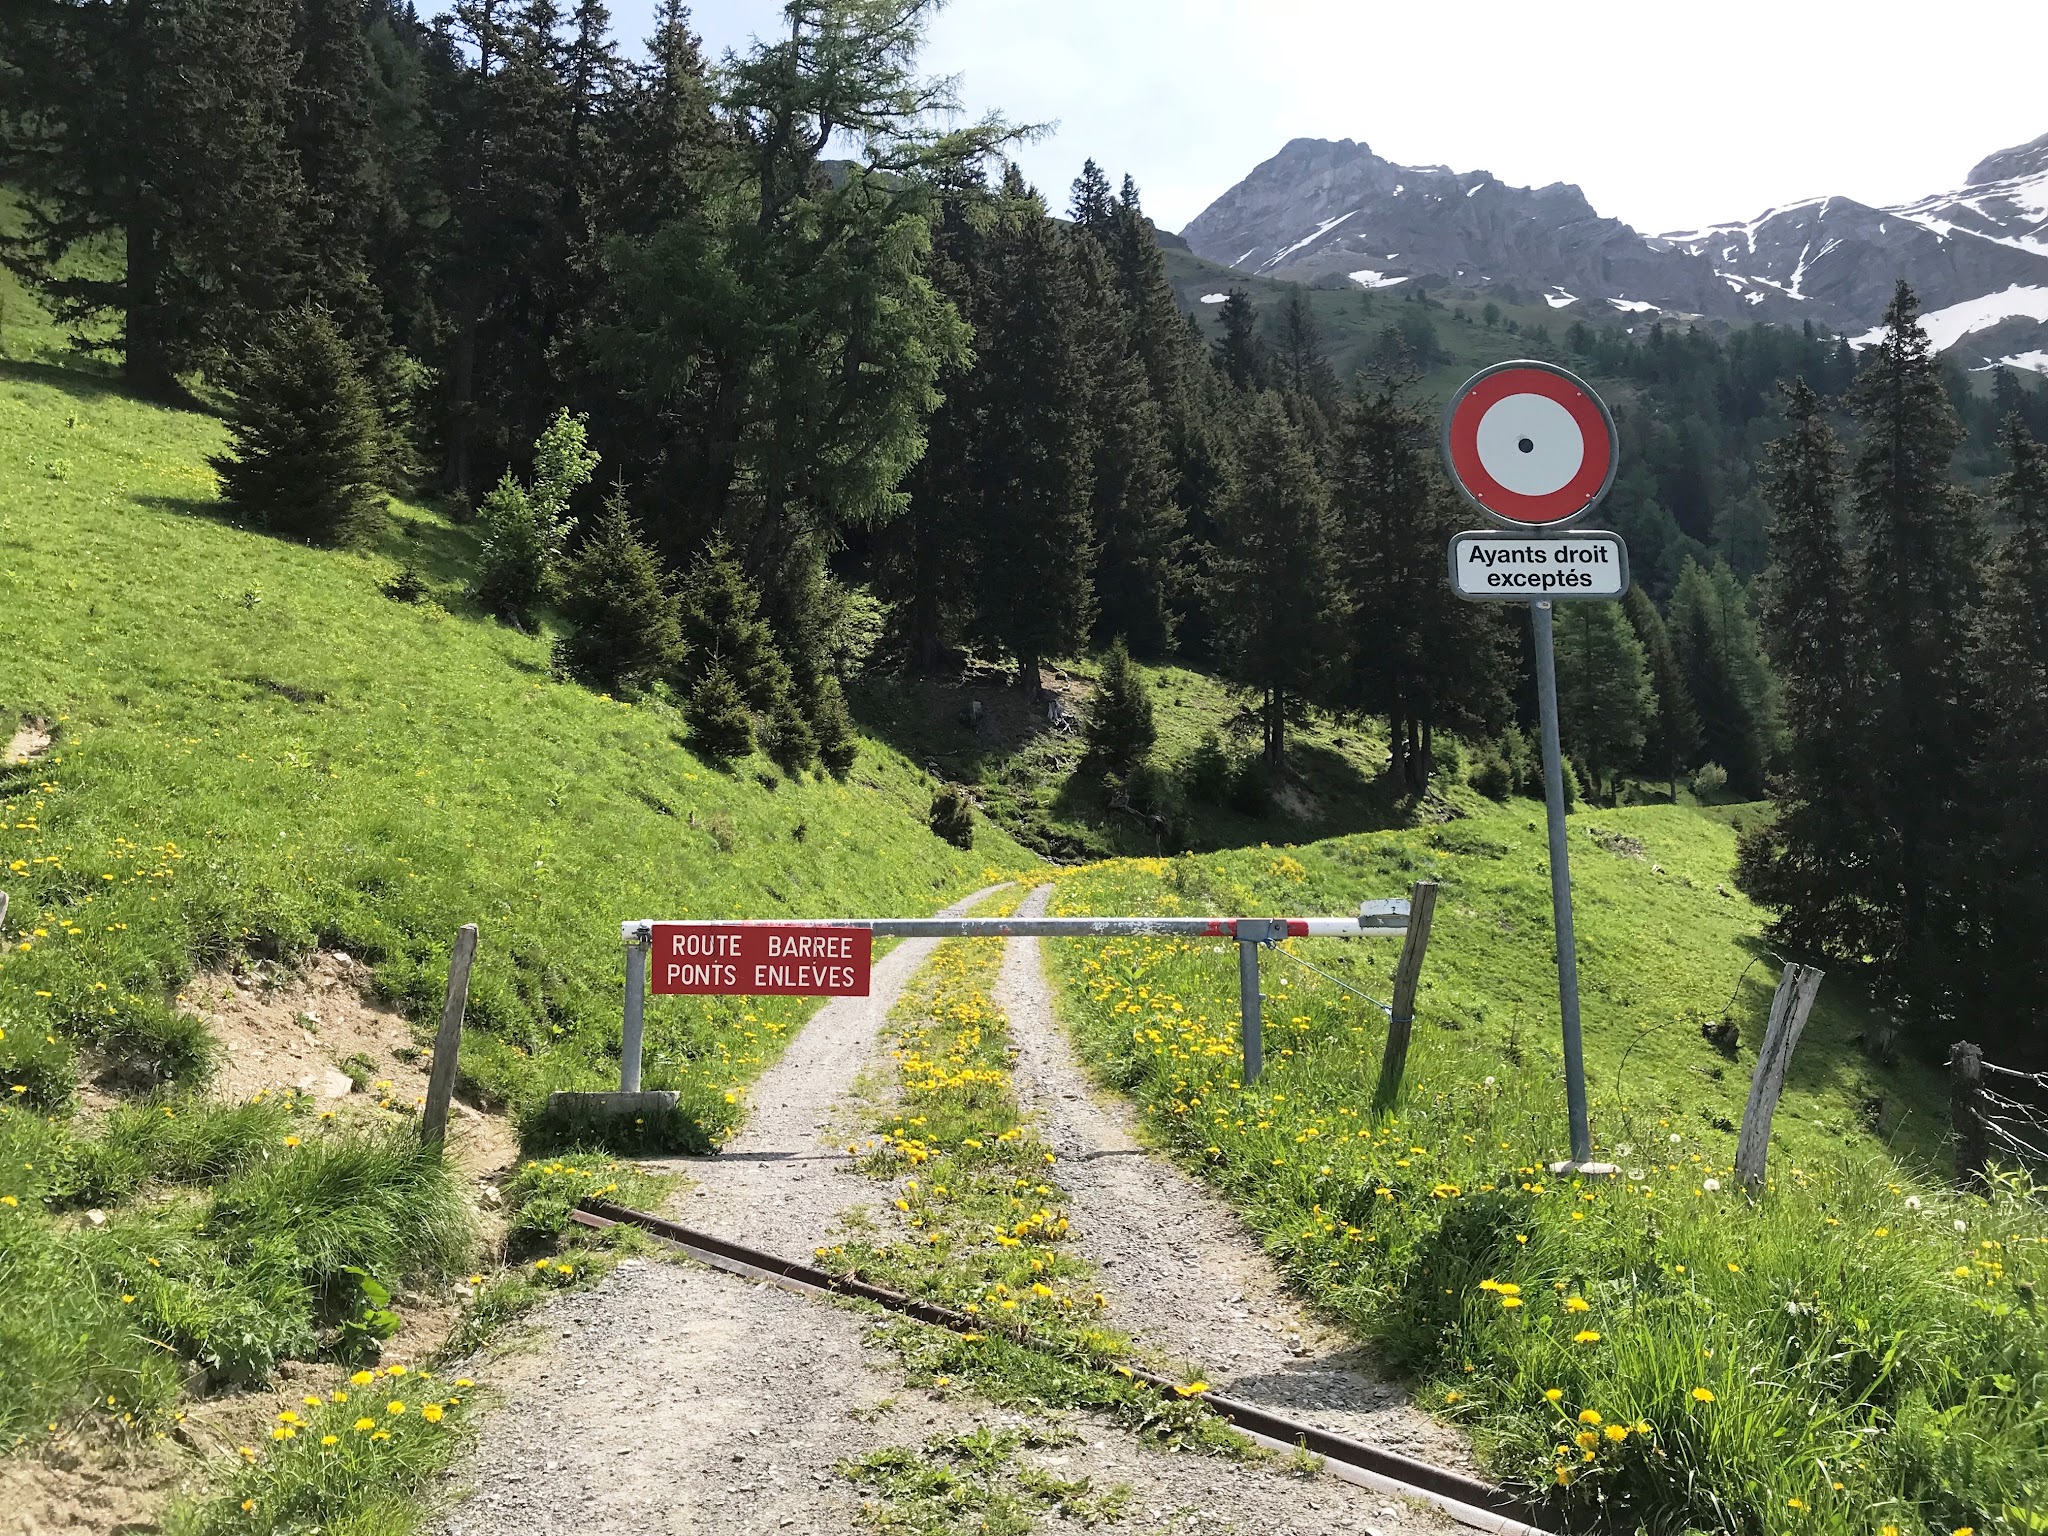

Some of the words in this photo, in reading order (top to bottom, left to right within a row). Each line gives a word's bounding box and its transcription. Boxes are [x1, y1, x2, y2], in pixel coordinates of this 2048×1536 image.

[1469, 545, 1547, 567] Ayants
[1554, 545, 1608, 563] droit
[1487, 568, 1592, 591] exceptés
[672, 935, 742, 957] ROUTE
[768, 936, 853, 958] BARREE
[667, 964, 737, 986] PONTS
[755, 965, 855, 987] ENLEVES
